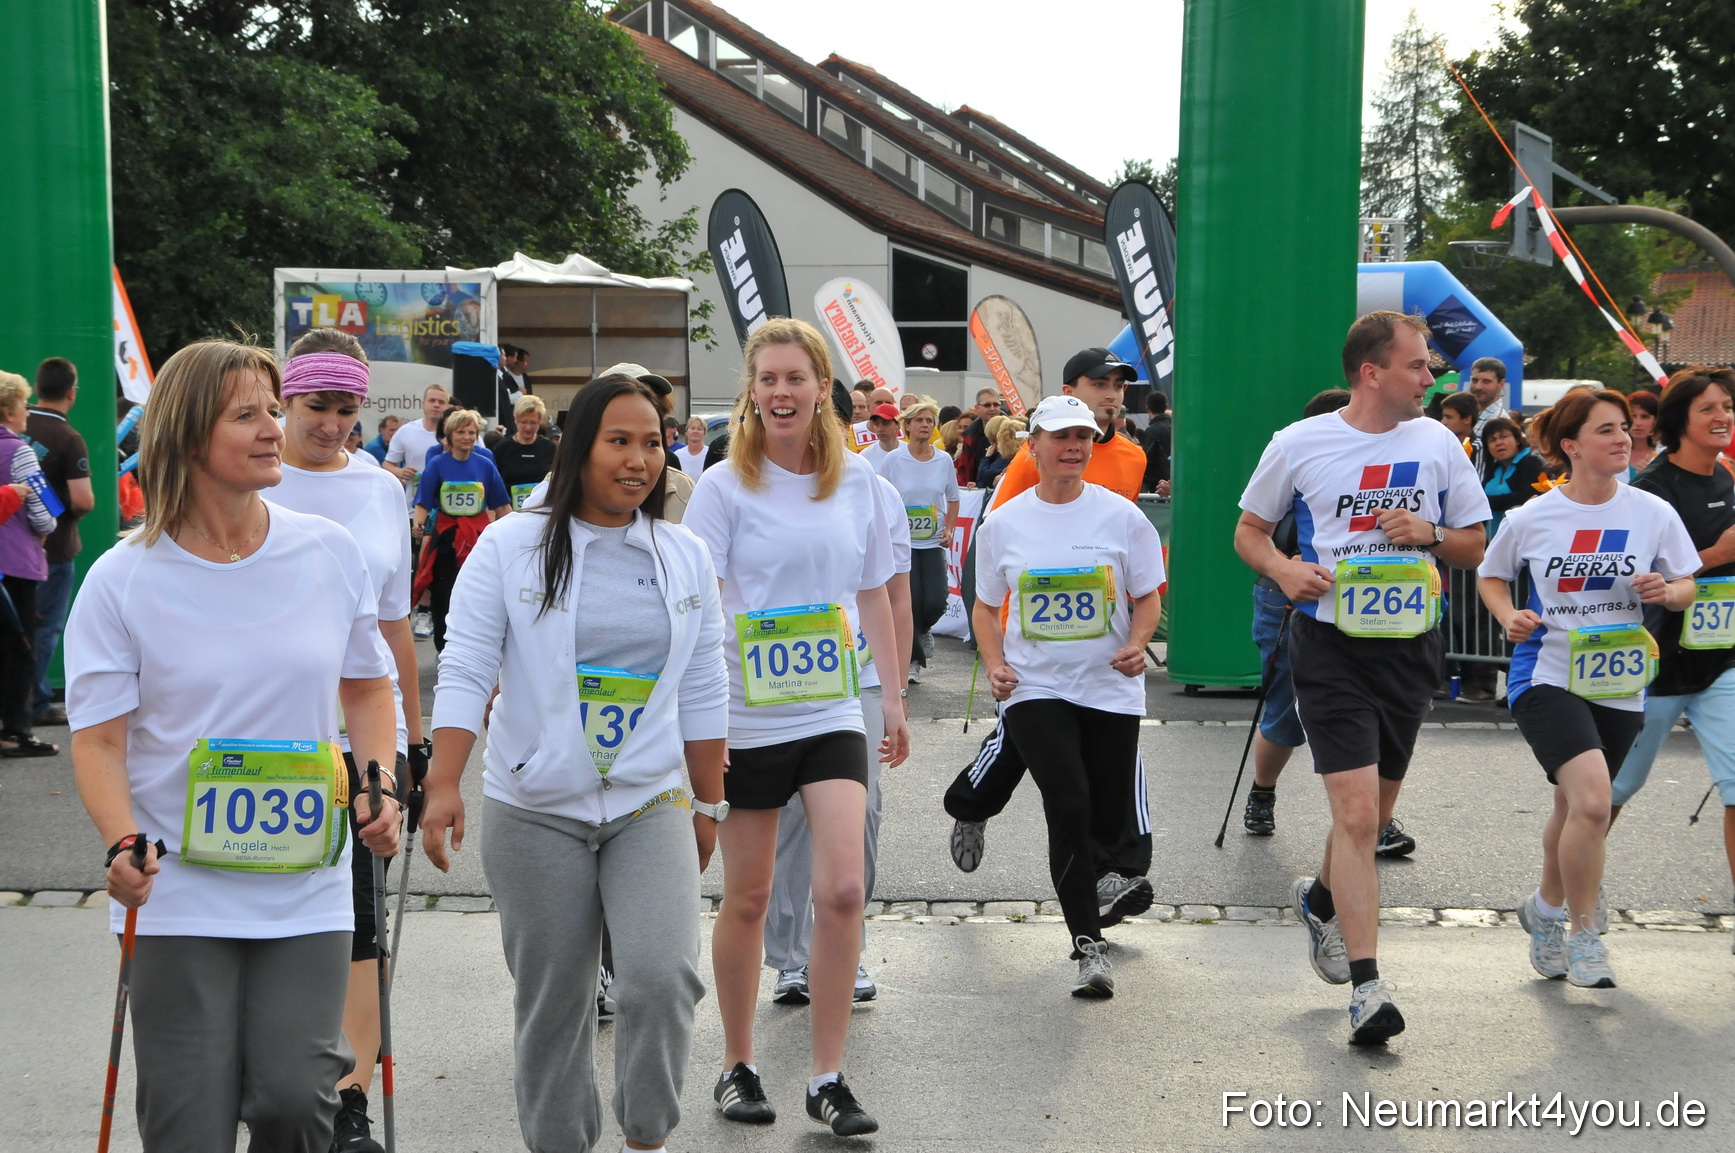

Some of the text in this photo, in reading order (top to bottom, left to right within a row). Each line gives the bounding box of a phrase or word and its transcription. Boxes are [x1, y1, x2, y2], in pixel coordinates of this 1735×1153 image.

[292, 302, 365, 326] TLA
[376, 314, 461, 340] Logistics
[446, 493, 475, 507] 155
[1355, 488, 1414, 500] AUTOHAUS
[1544, 555, 1637, 578] PERRAS
[1564, 553, 1623, 563] AUTOHAUS
[1030, 592, 1096, 623] 238
[1341, 586, 1425, 615] 1264
[1040, 623, 1075, 631] Christine
[1360, 617, 1387, 626] Stefan
[1692, 601, 1735, 631] 537
[747, 638, 839, 679] 1038
[1575, 649, 1645, 680] 1263
[768, 679, 802, 690] Martina
[211, 765, 263, 776] firmenlauf
[197, 787, 325, 836] 1039
[222, 839, 267, 853] Angela
